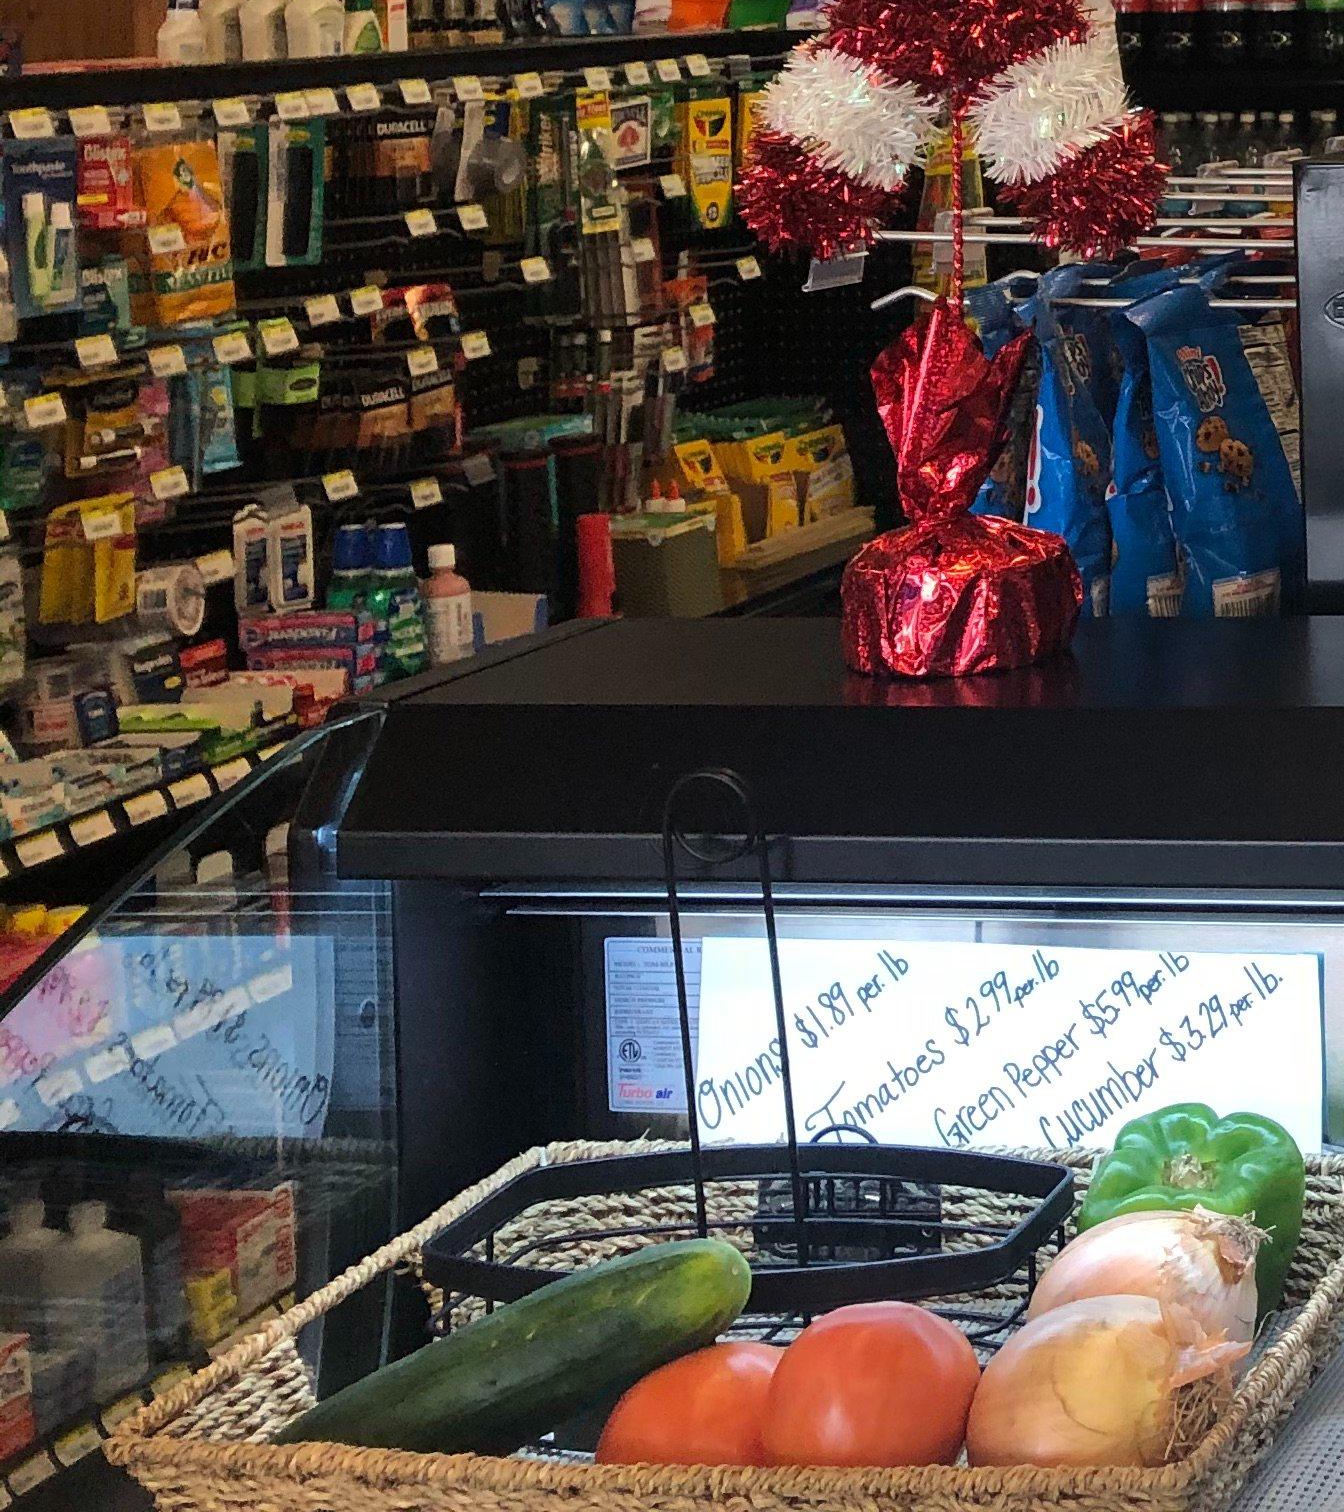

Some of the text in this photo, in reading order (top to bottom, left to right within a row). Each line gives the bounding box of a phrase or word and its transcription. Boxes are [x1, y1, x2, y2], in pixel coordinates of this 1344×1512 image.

[376, 119, 427, 135] DURACELL
[617, 1082, 674, 1100] Turbo air
[697, 1037, 784, 1129] Onions
[793, 981, 855, 1049] $1.89
[856, 974, 886, 1013] per.
[876, 949, 909, 982] lb
[804, 1038, 946, 1145] Tomatoes
[1013, 977, 1039, 1009] per.
[1031, 948, 1060, 983] lb
[934, 1086, 1016, 1147] Green
[1002, 1022, 1080, 1099] Pepper
[1159, 951, 1191, 978] lb
[1038, 1045, 1160, 1149] Cucumber
[1229, 992, 1255, 1027] per.
